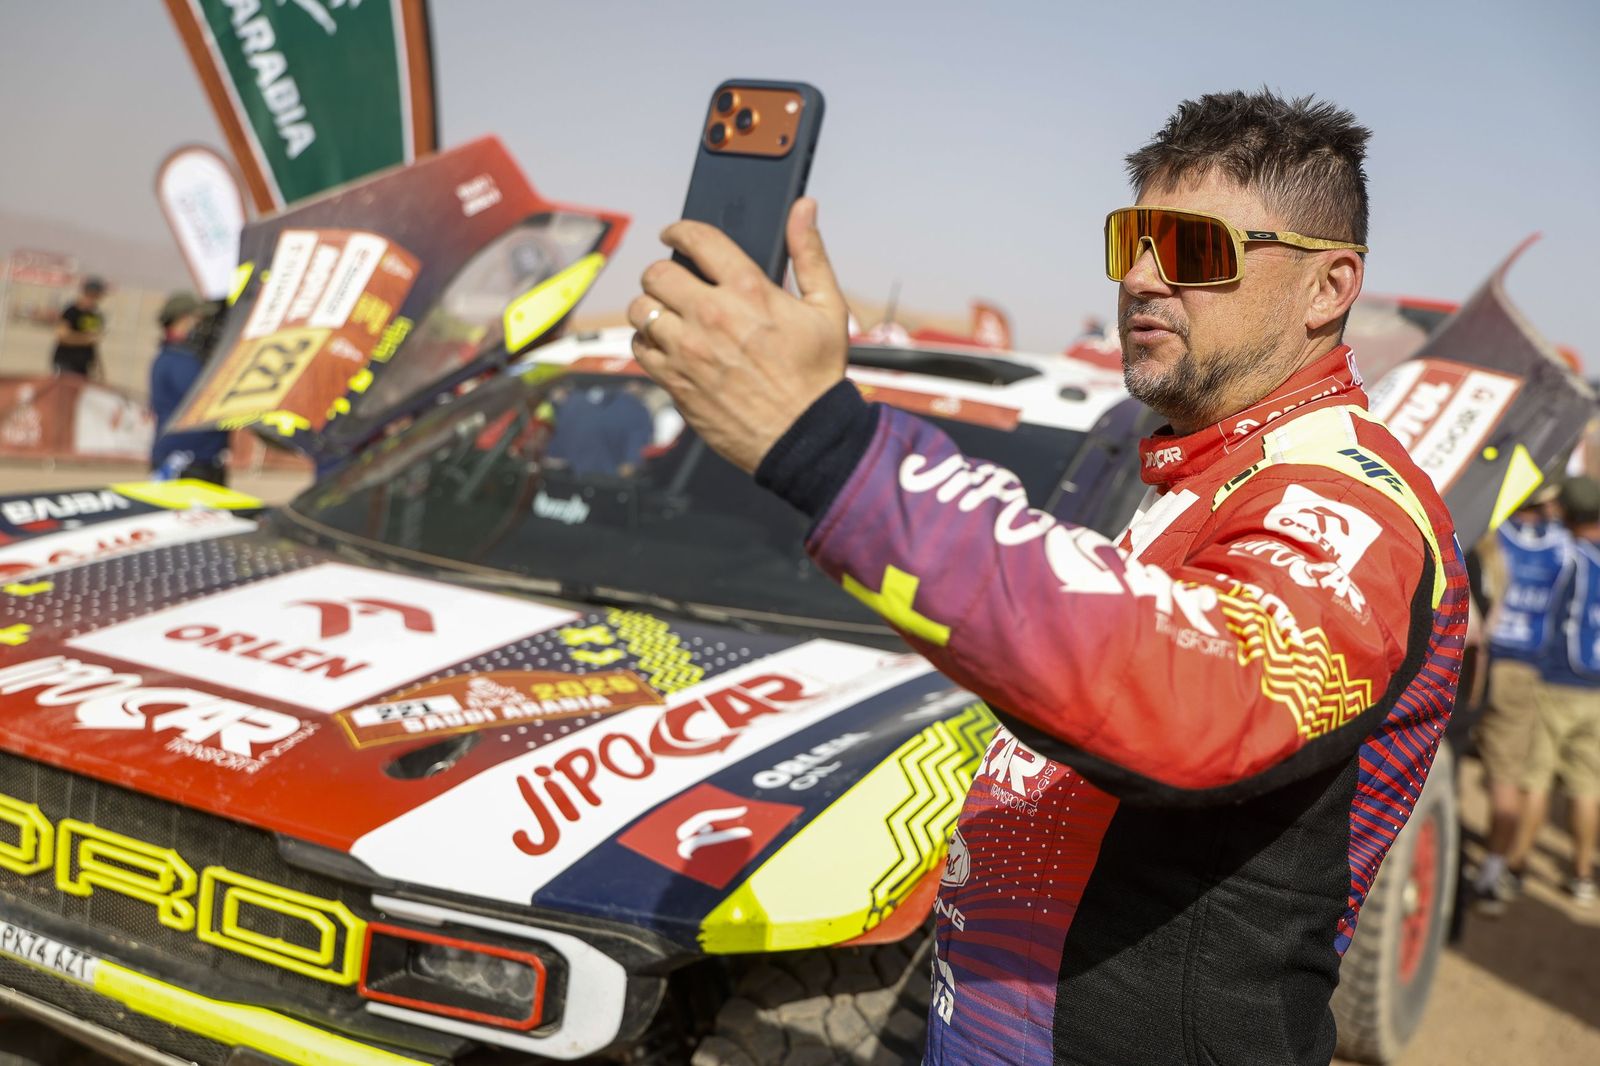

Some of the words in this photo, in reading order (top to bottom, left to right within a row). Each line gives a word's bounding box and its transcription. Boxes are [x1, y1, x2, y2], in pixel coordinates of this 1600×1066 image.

[222, 0, 316, 160] ARABIA
[164, 624, 370, 681] ORLEN
[376, 701, 433, 721] 221
[530, 675, 638, 701] 2026
[401, 706, 497, 734] SAUDI
[502, 693, 613, 719] ARABIA
[991, 783, 1028, 814] TRANSPORT
[1026, 759, 1057, 809] LOGIST
